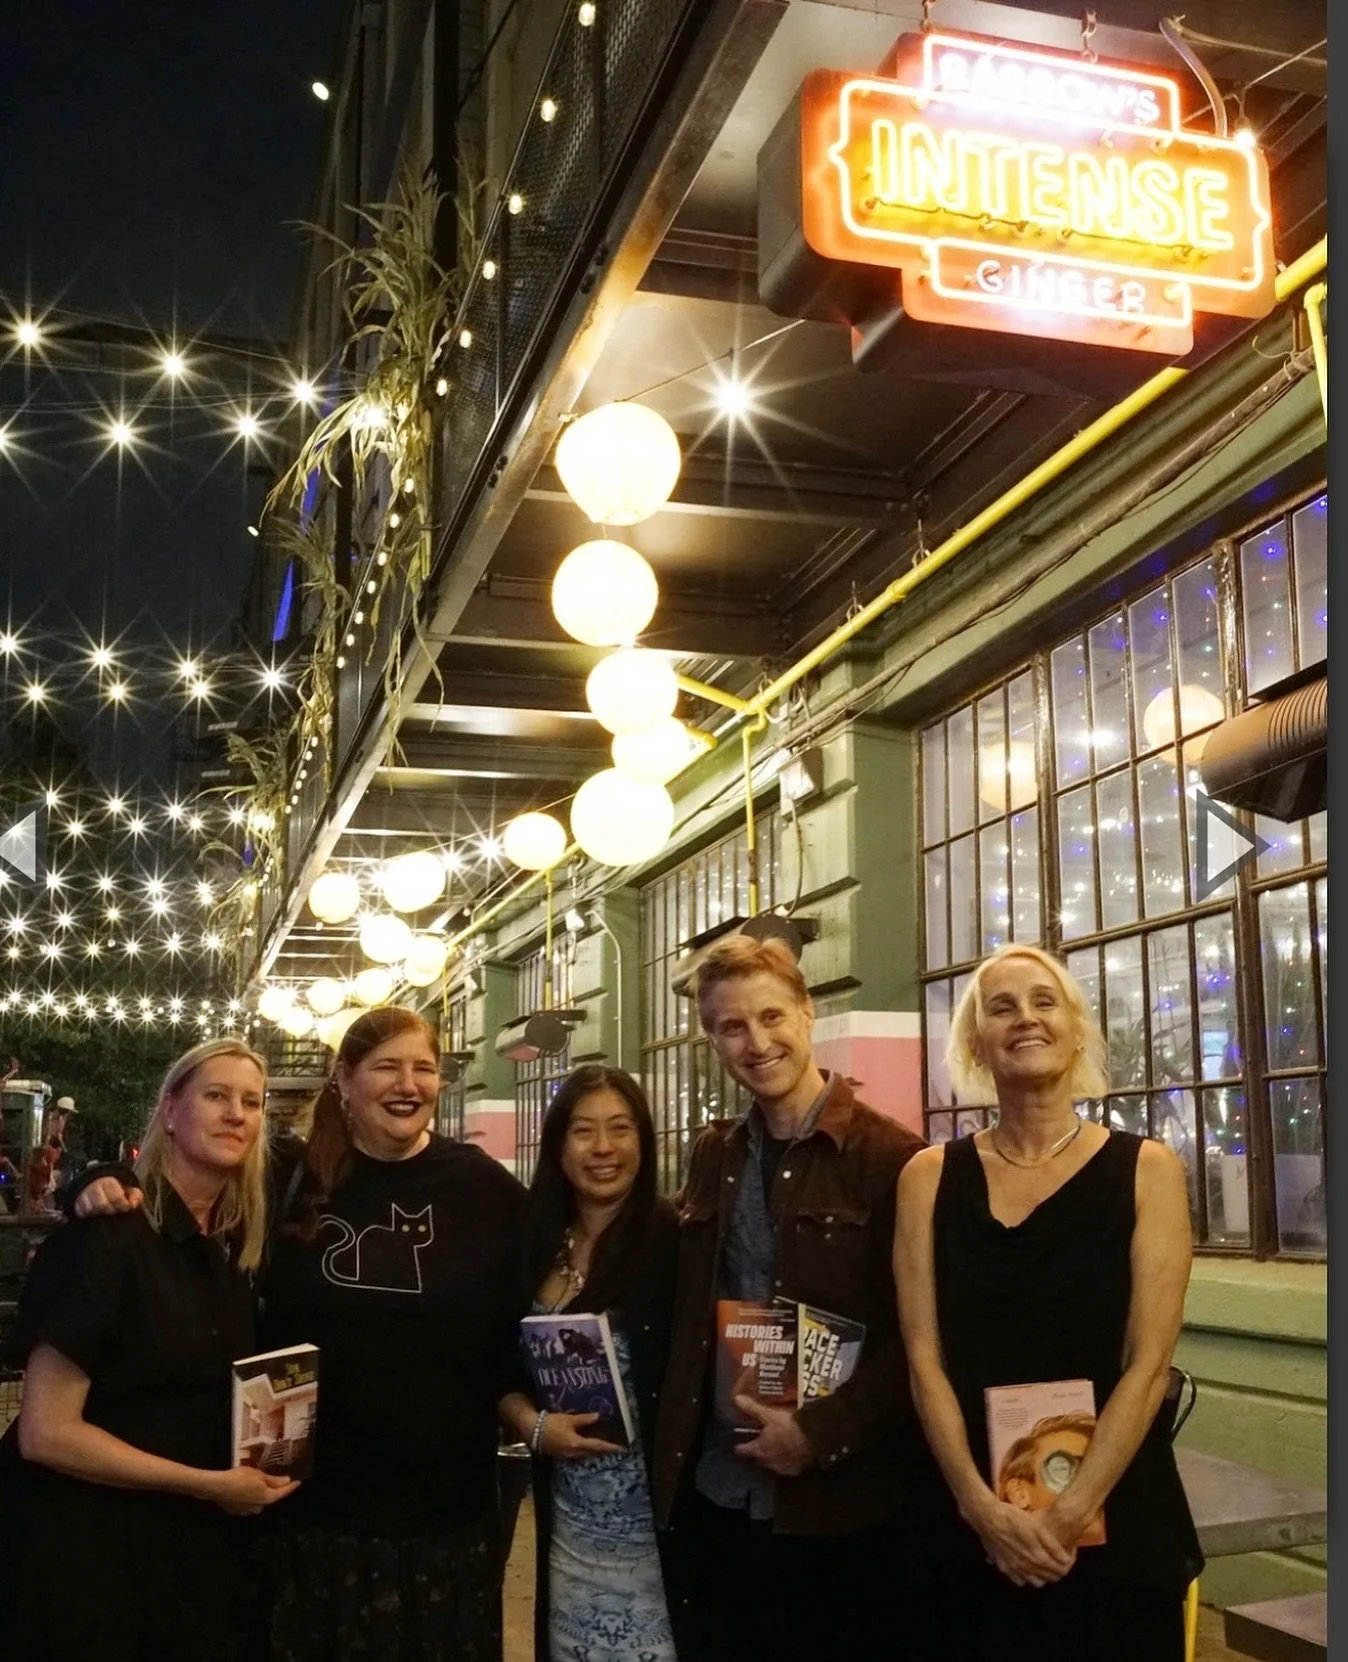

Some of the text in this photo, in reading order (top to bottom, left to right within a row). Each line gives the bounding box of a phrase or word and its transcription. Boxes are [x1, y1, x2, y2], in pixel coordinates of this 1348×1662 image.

[871, 118, 1234, 250] INTENSE
[976, 260, 1147, 314] GINGER
[725, 1324, 784, 1340] HISTORIES
[753, 1340, 795, 1355] WITHIN
[742, 1353, 757, 1367] US
